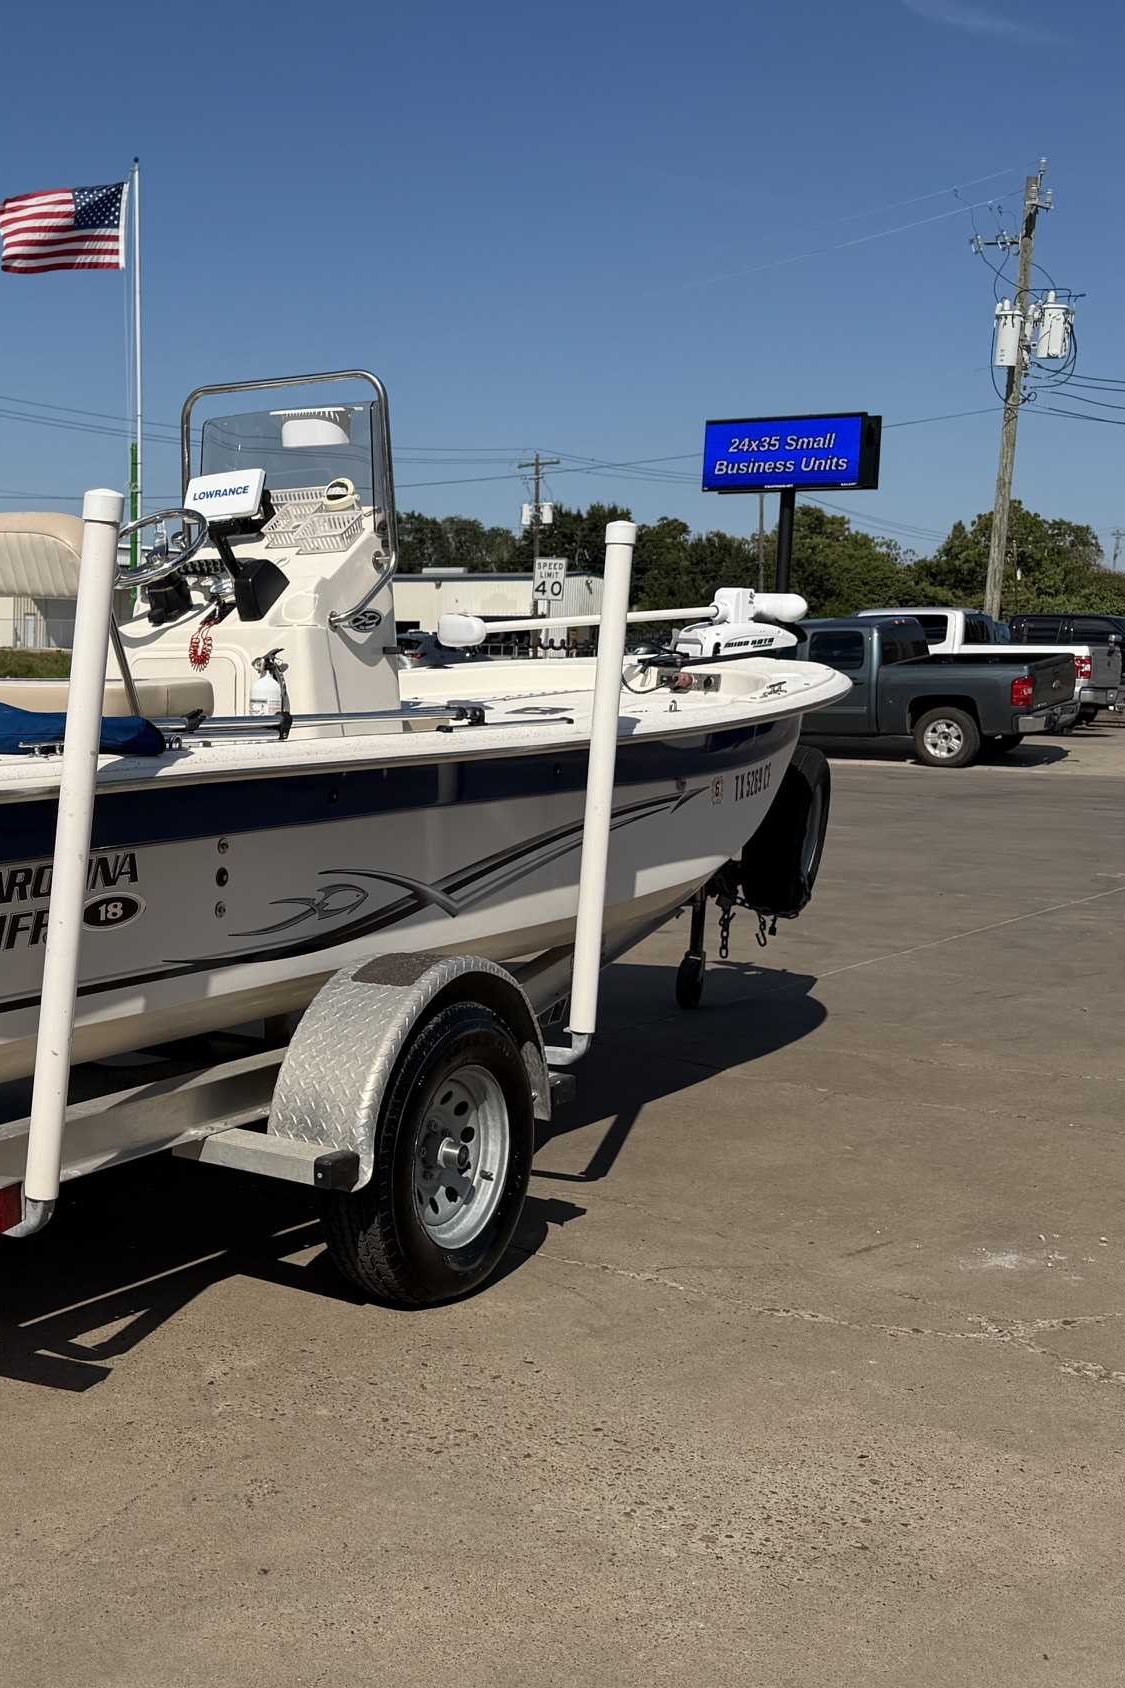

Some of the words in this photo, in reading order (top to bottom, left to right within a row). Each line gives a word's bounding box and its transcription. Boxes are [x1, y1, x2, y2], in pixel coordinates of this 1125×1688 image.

[728, 436, 780, 453] 24x35
[785, 433, 836, 450] Small
[715, 458, 795, 475] Business
[801, 455, 848, 471] Units
[193, 485, 250, 501] LOWRANCE
[537, 562, 564, 570] SPEED
[535, 580, 562, 596] 40
[735, 774, 745, 802] TX
[98, 901, 124, 921] 18
